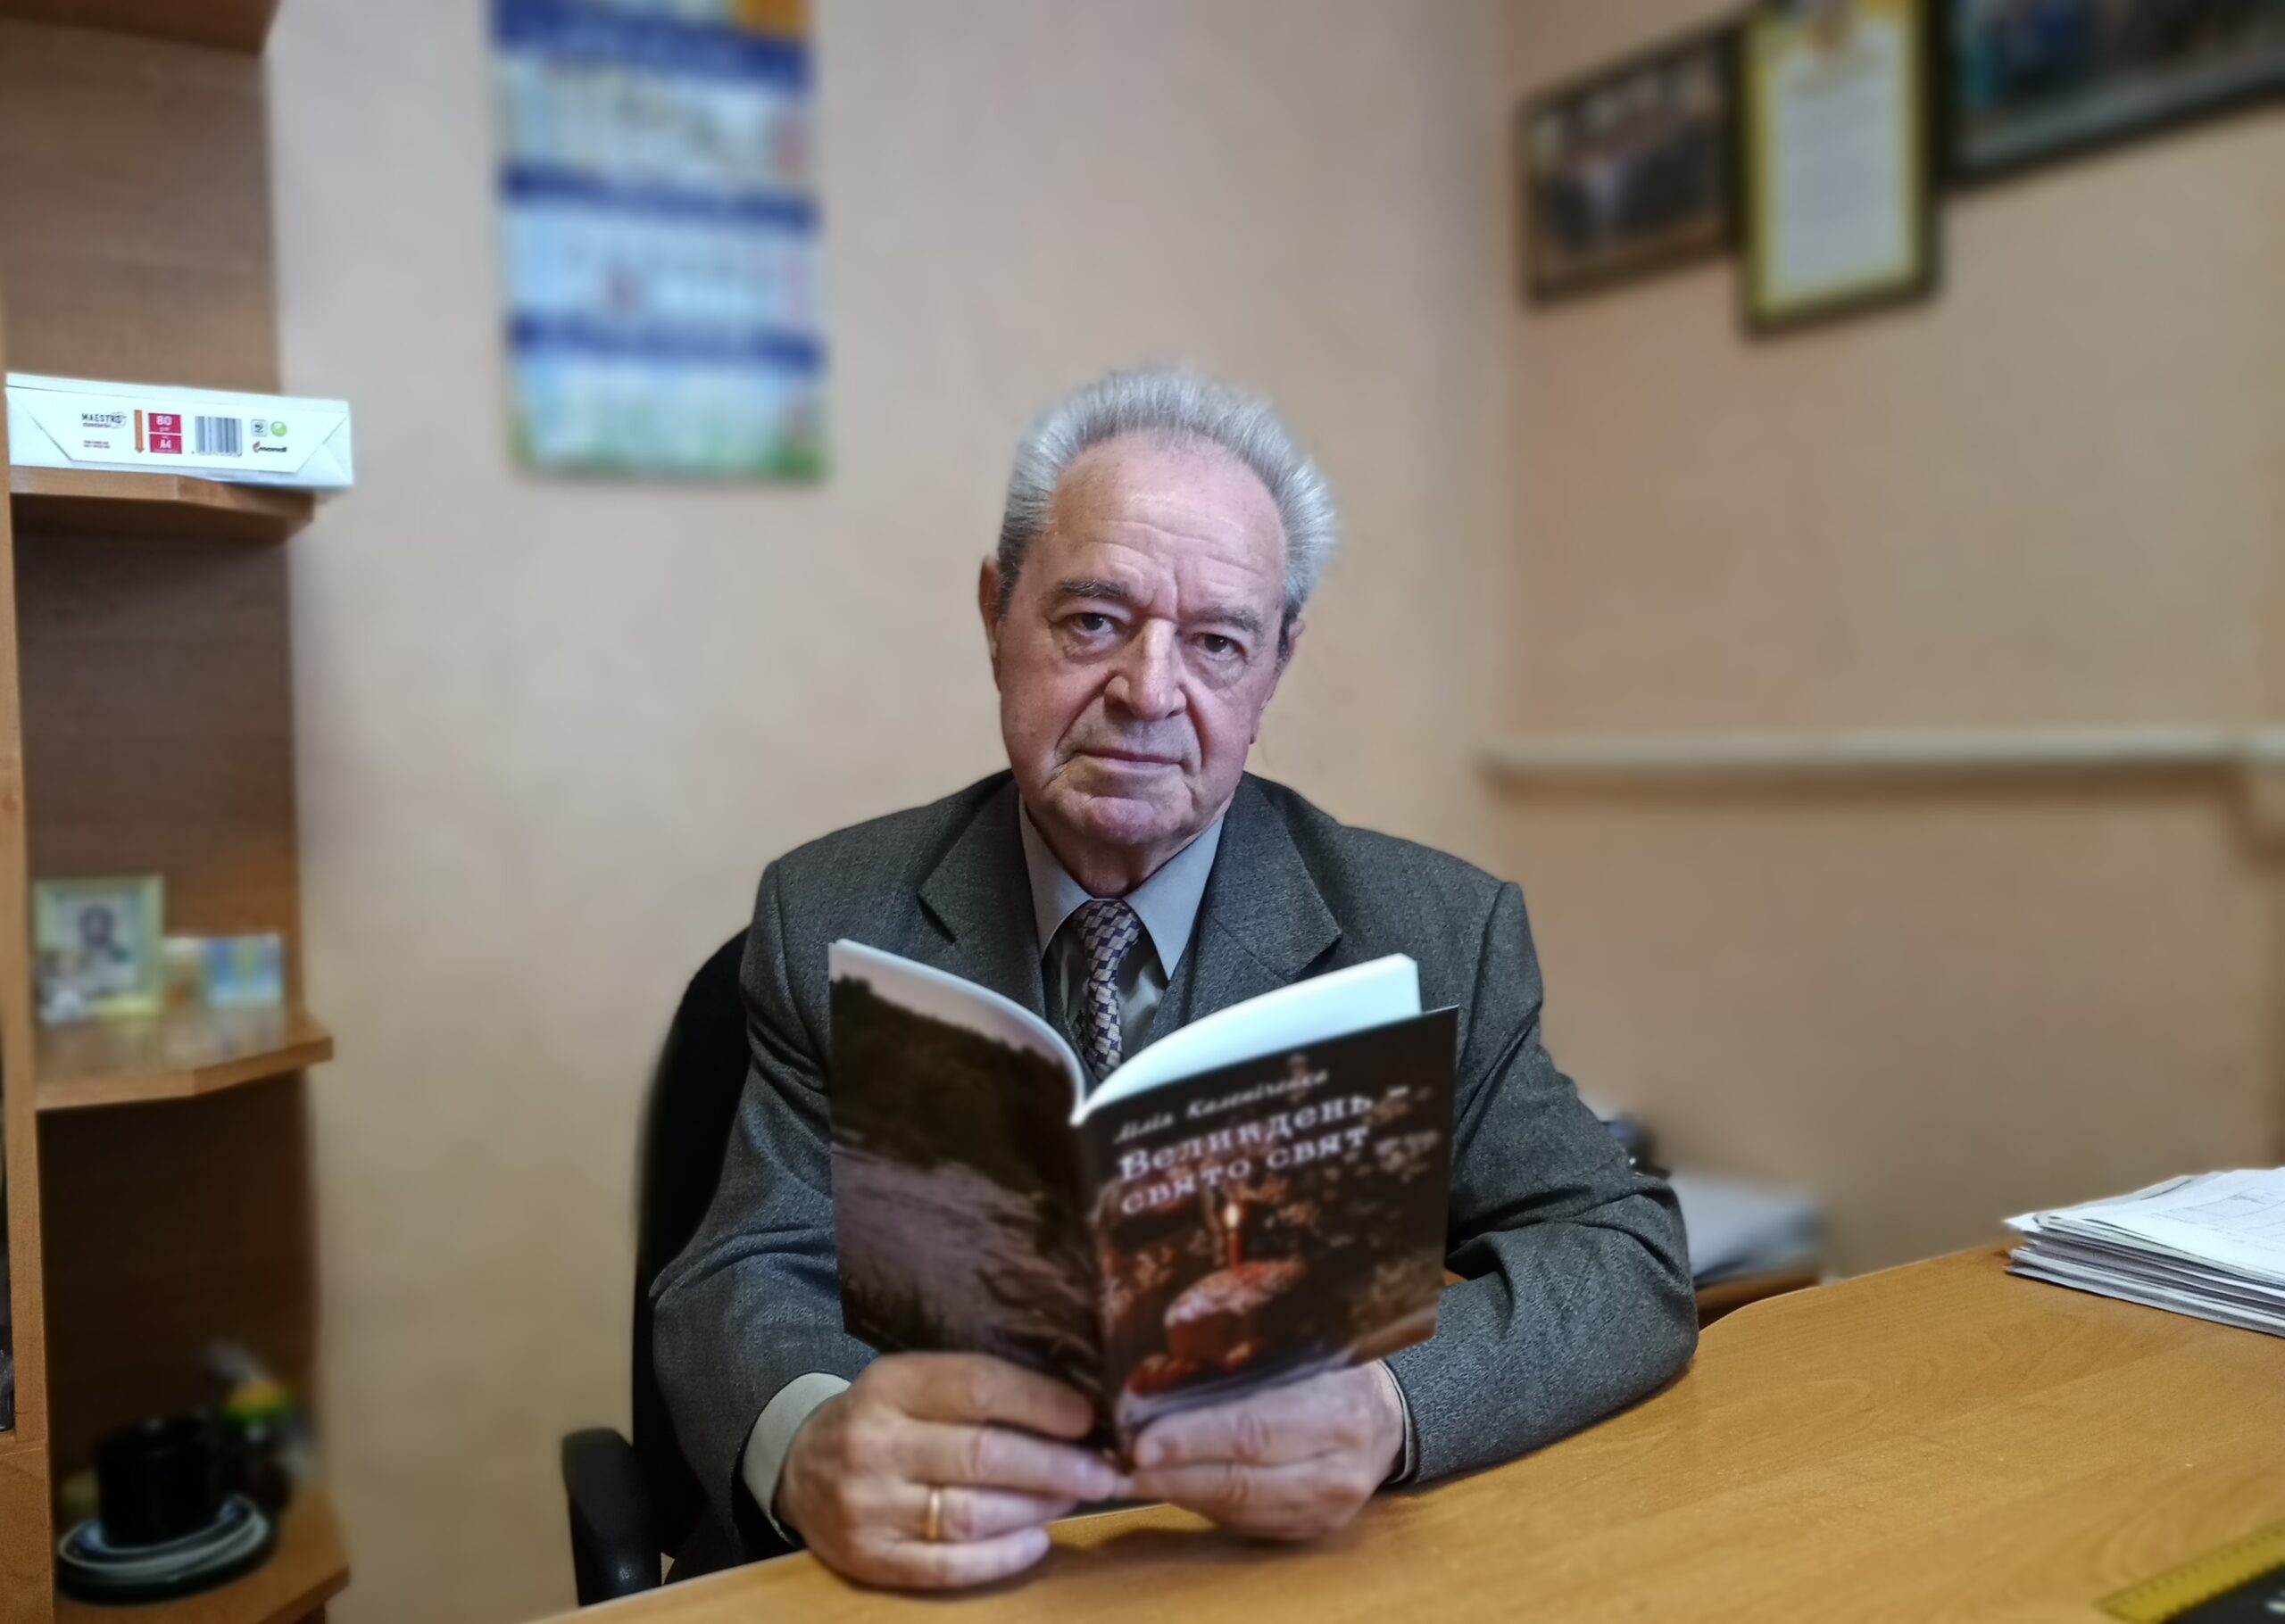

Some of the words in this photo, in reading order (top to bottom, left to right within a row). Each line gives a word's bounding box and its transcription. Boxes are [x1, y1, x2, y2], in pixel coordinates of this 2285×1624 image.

[81, 413, 123, 424] MAESTRO
[156, 415, 172, 426] 80
[1119, 1095, 1373, 1181] Великдень
[1122, 1159, 1251, 1214] свято
[1266, 1125, 1370, 1170] свят
